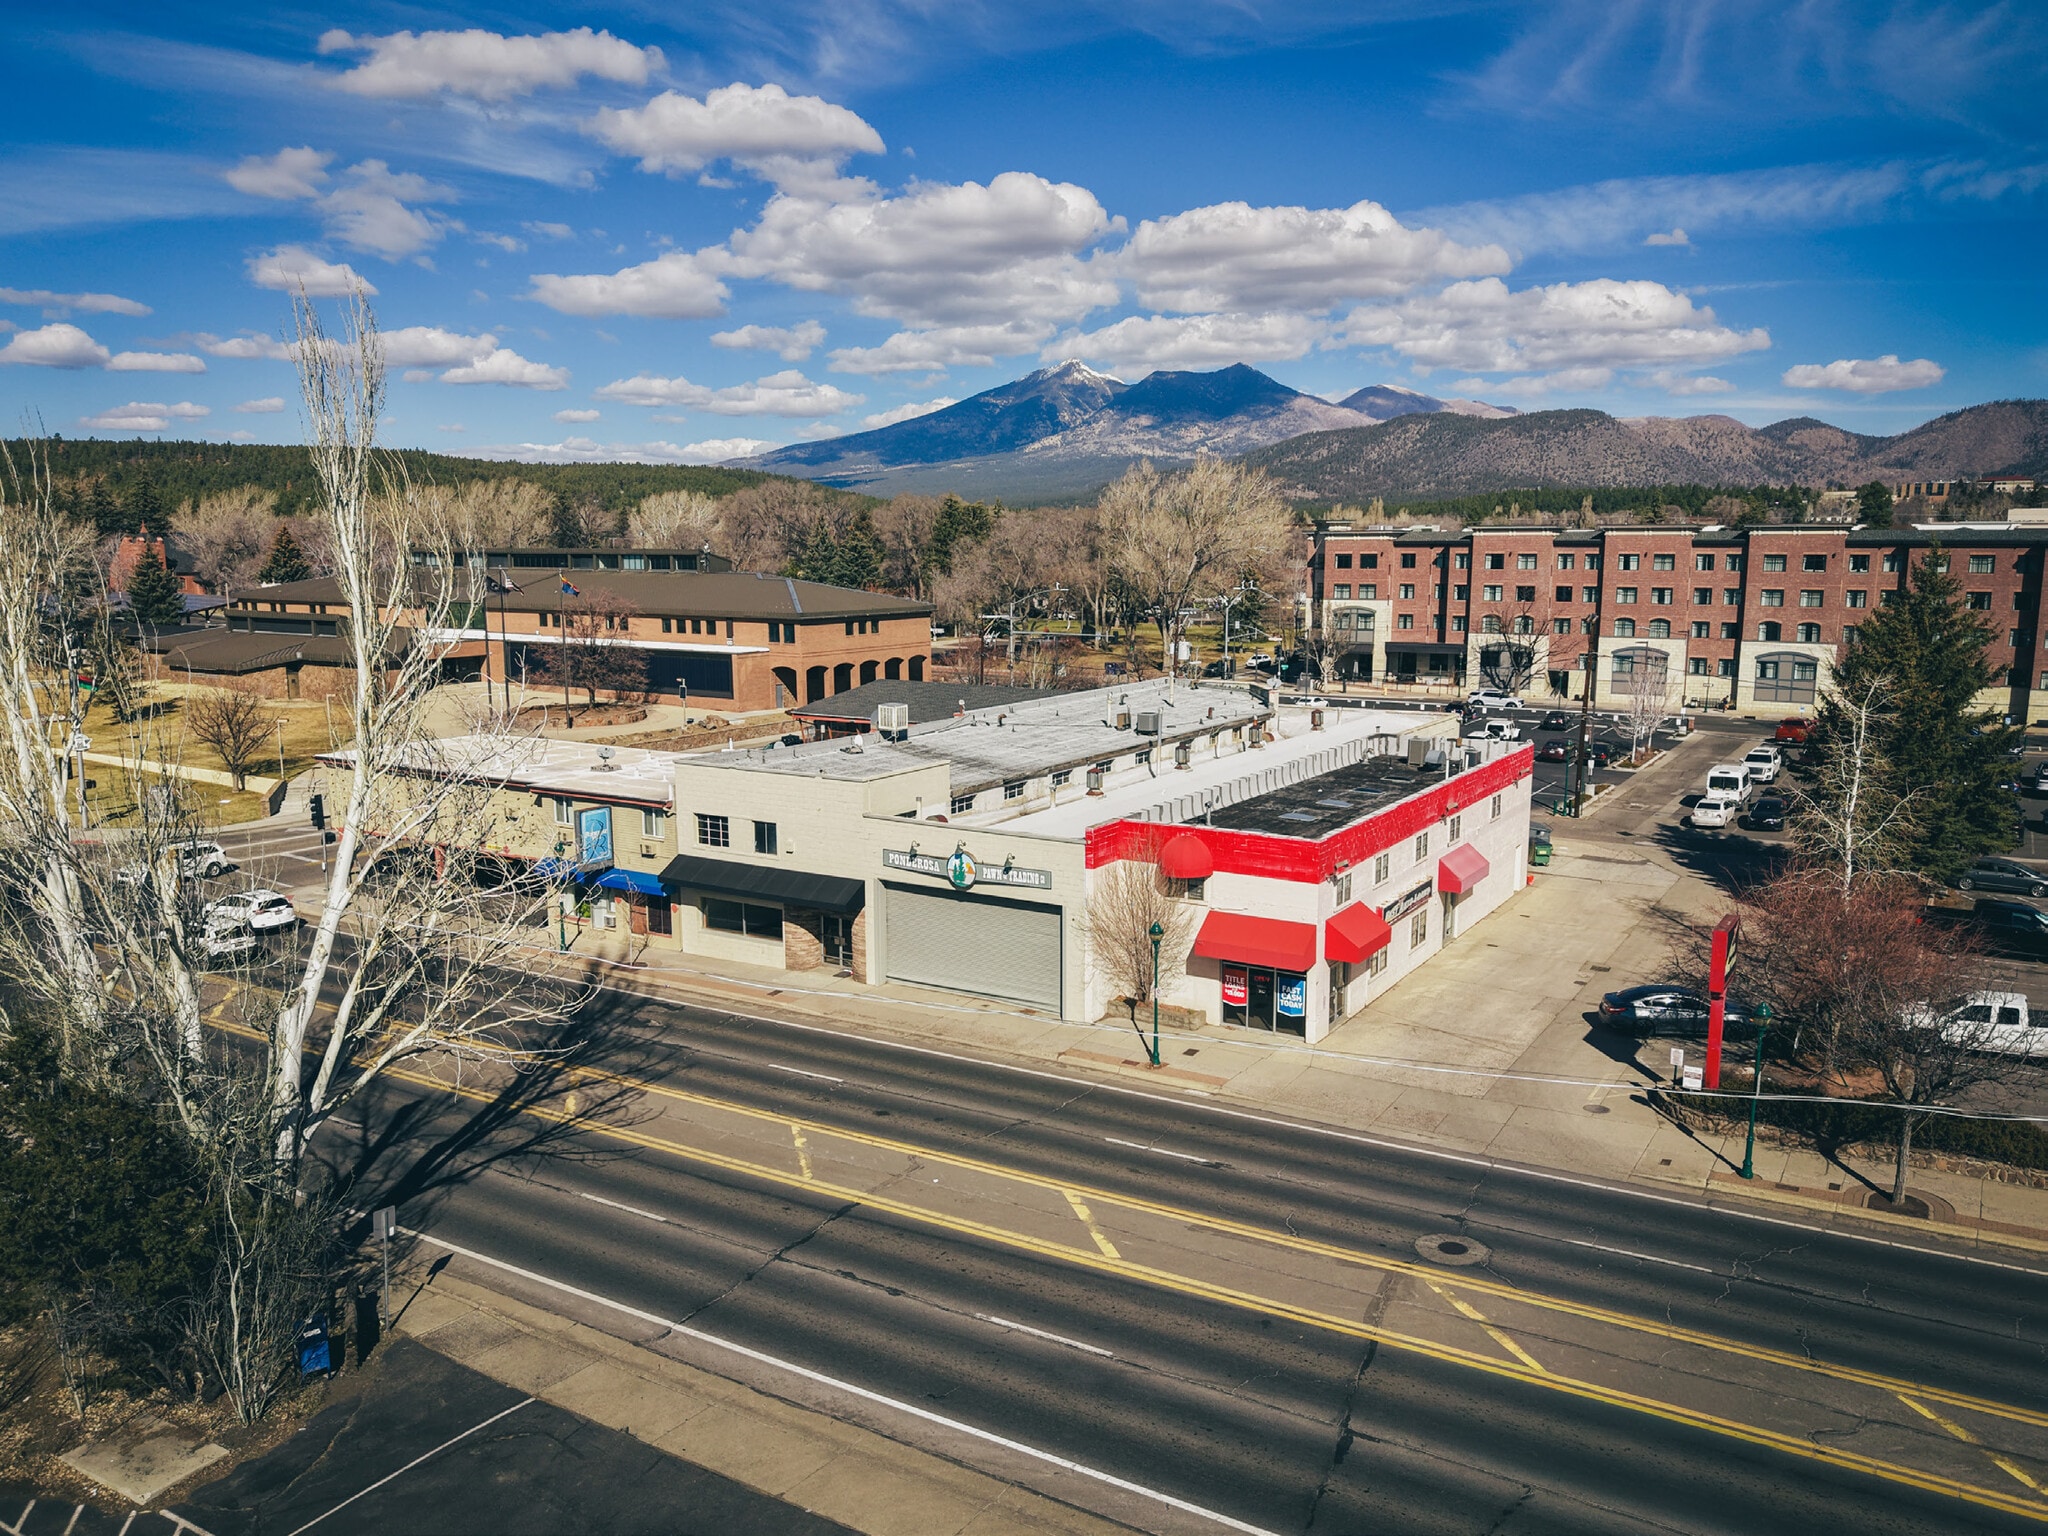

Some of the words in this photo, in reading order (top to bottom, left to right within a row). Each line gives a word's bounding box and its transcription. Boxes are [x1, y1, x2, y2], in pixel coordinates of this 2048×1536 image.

[888, 853, 940, 872] PONDEROSA
[982, 867, 1003, 881] PAWN
[1008, 870, 1040, 885] TRADING
[1225, 975, 1245, 984] TITLE
[1282, 985, 1301, 995] FAST
[1281, 992, 1303, 1003] CASH
[1280, 999, 1304, 1009] TODAY
